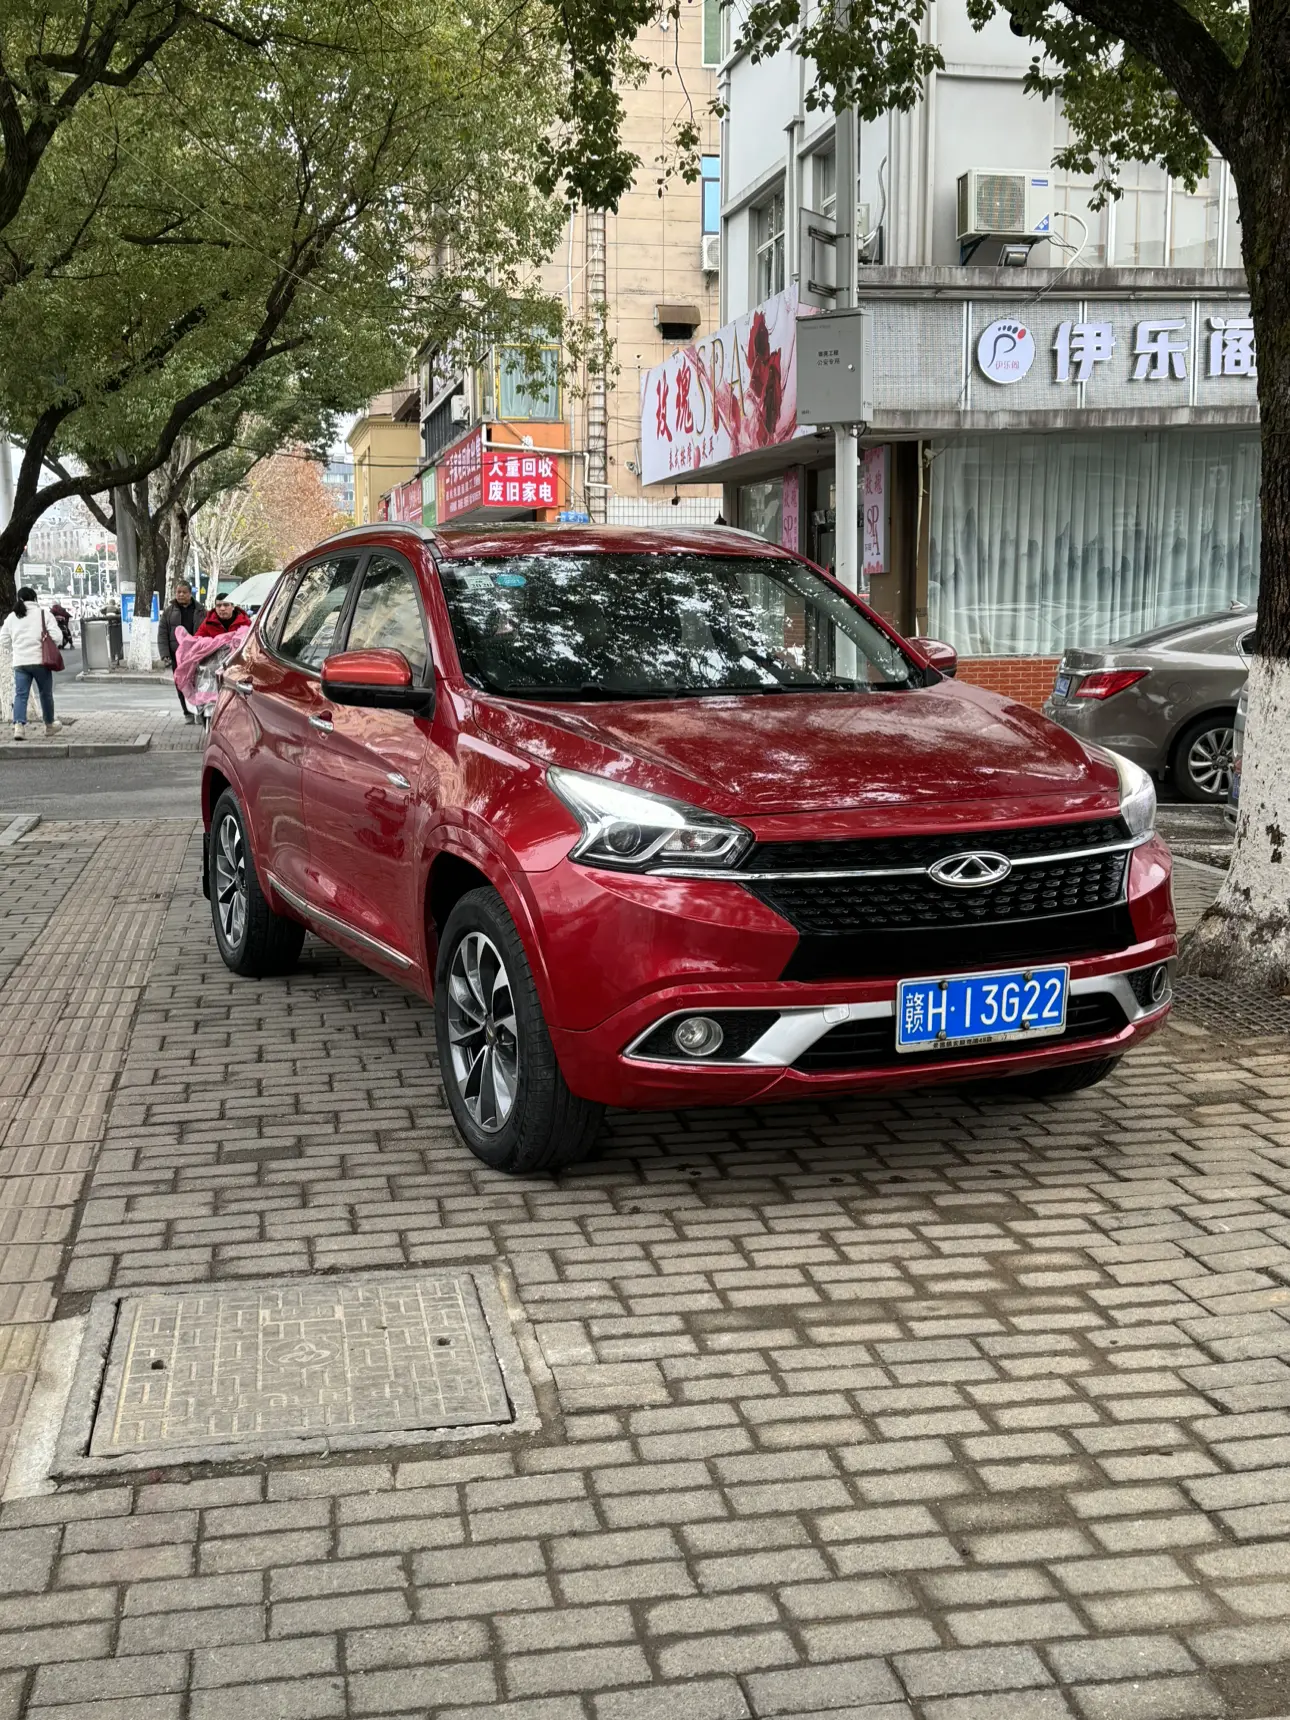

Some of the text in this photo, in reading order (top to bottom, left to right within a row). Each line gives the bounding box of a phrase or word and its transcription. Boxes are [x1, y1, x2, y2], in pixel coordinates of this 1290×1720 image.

[1053, 316, 1257, 384] 伊乐阁
[488, 455, 554, 478] 大量回收
[488, 481, 554, 503] 废旧家电
